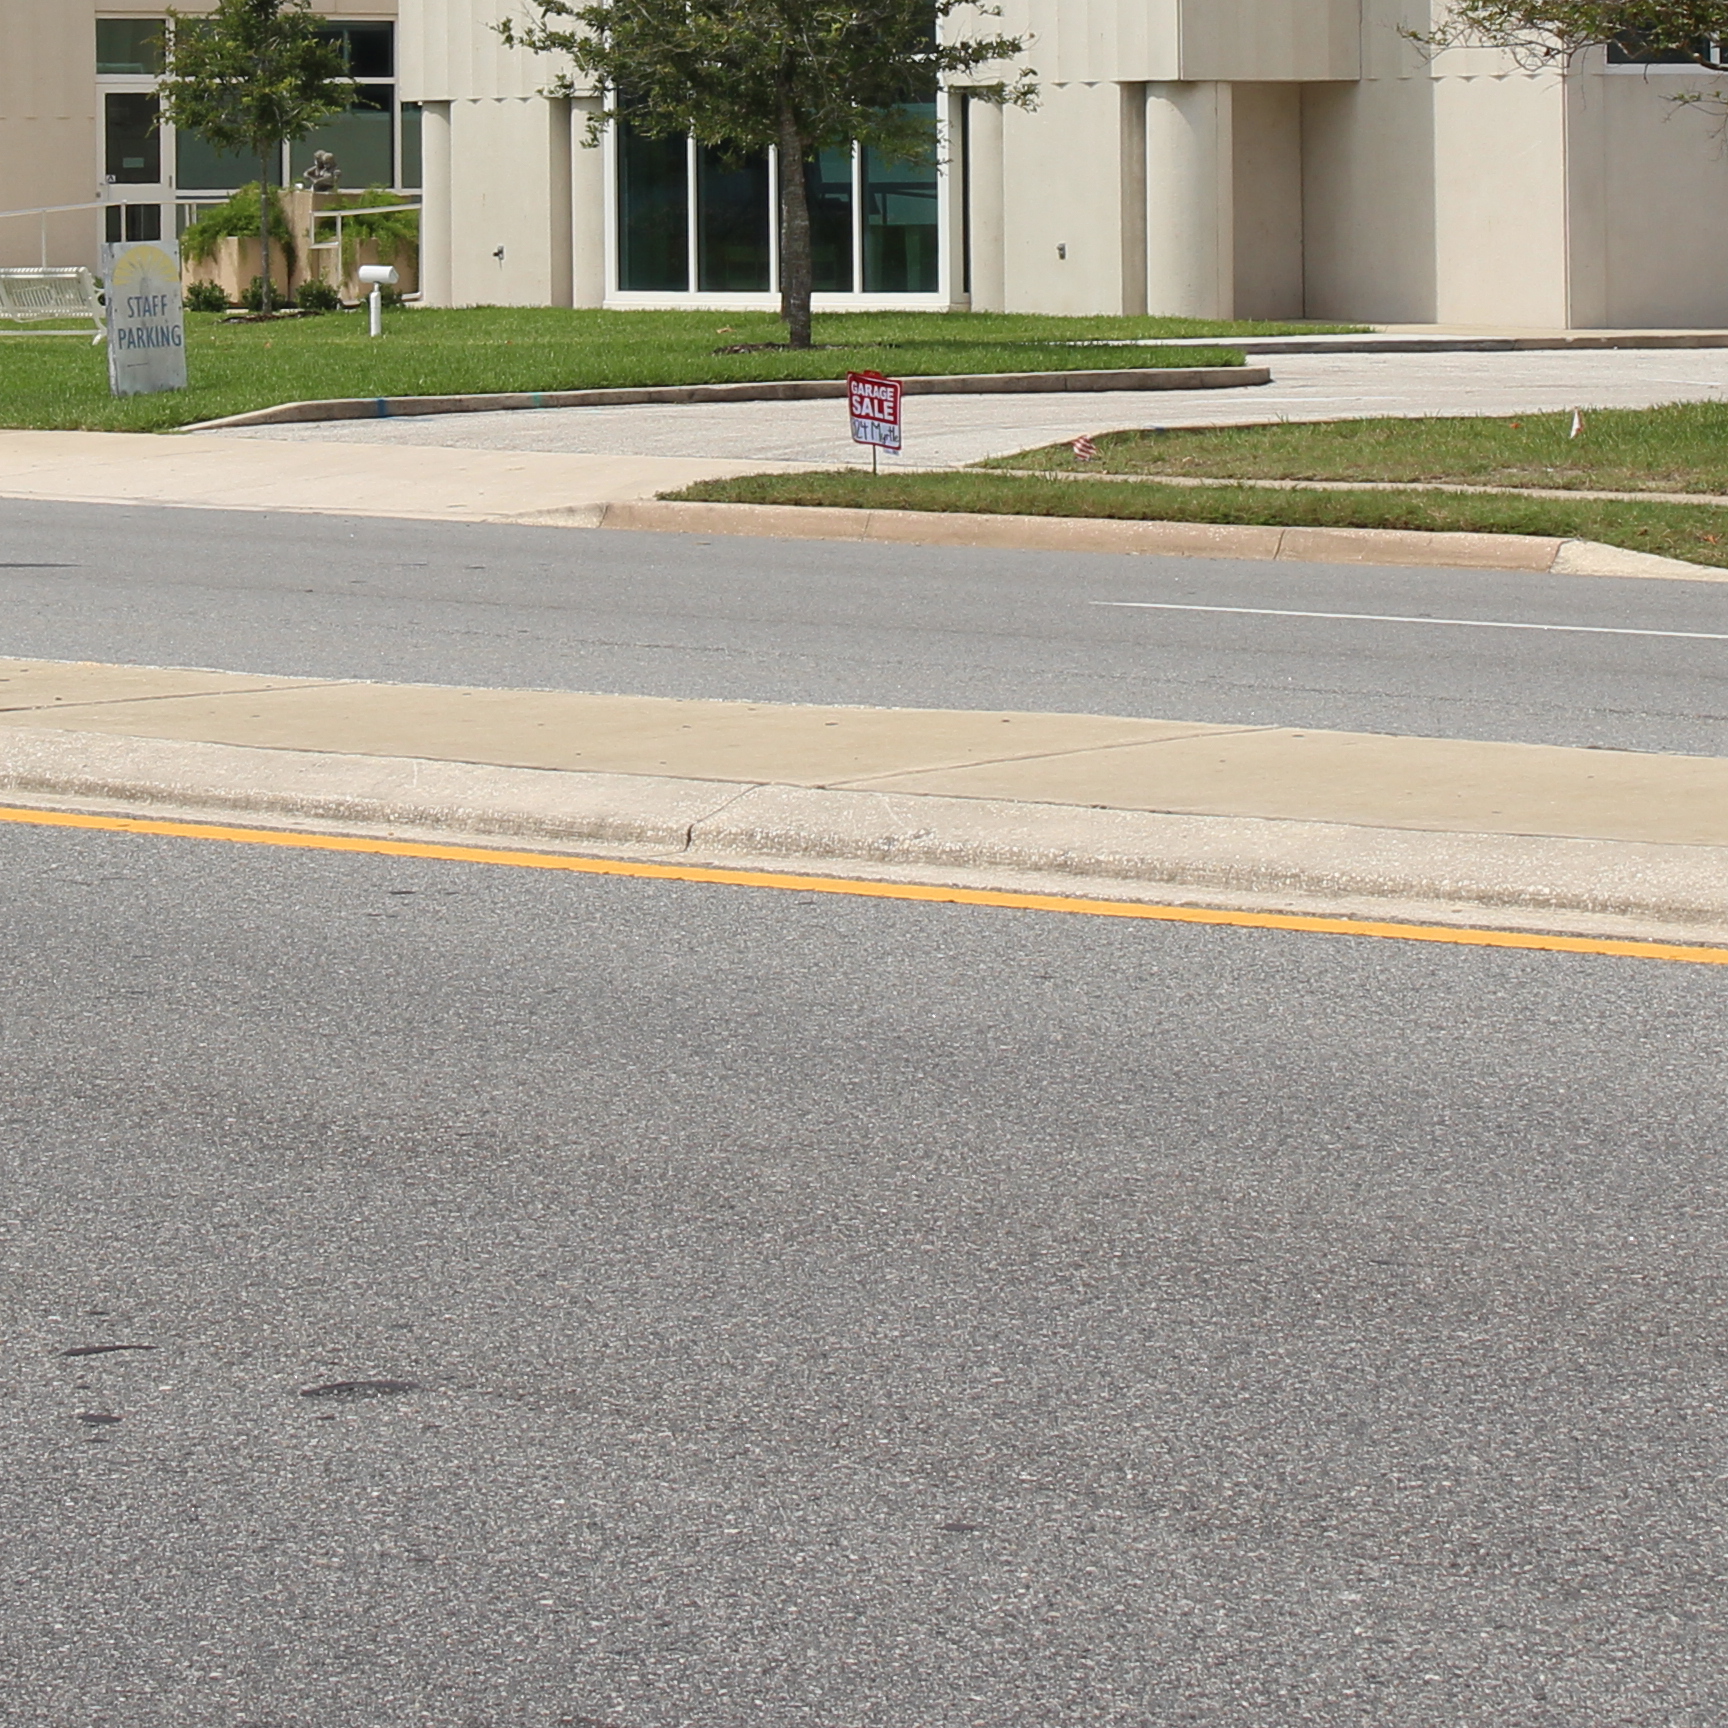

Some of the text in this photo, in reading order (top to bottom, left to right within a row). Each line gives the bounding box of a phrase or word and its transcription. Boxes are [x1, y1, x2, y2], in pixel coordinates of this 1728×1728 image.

[127, 294, 168, 318] STAFF
[118, 325, 182, 350] PARKING
[851, 381, 894, 401] GARAGE
[852, 395, 894, 421] SALE
